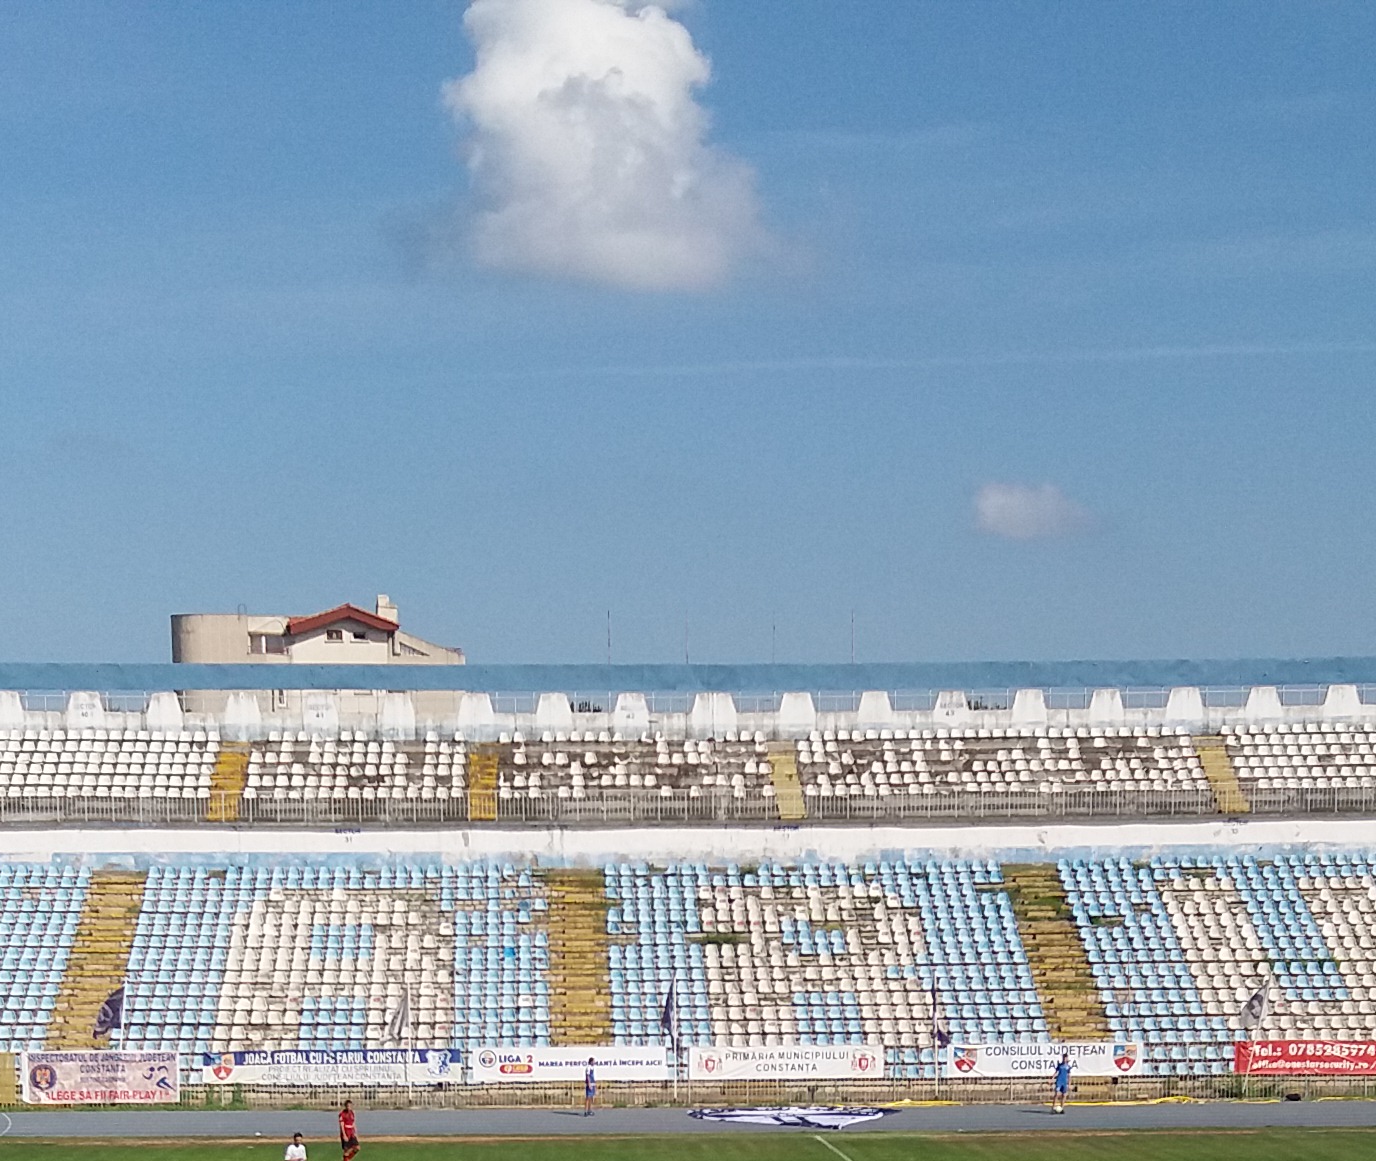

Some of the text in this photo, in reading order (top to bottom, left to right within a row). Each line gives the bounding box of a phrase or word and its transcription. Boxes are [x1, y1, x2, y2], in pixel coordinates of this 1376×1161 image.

[985, 1046, 1043, 1056] CONSILIUL
[1253, 1044, 1282, 1056] Tel.:
[28, 1053, 87, 1062] INSPECTORATUL
[90, 1053, 98, 1062] DE
[274, 1052, 308, 1064] FOTBAL
[309, 1052, 322, 1064] CU
[337, 1051, 365, 1063] FARUL
[499, 1055, 533, 1063] LIGA 2
[778, 1051, 849, 1060] MUNICIPIULUI
[95, 1090, 106, 1100] FII
[108, 1090, 156, 1100] FAIR-PLAY
